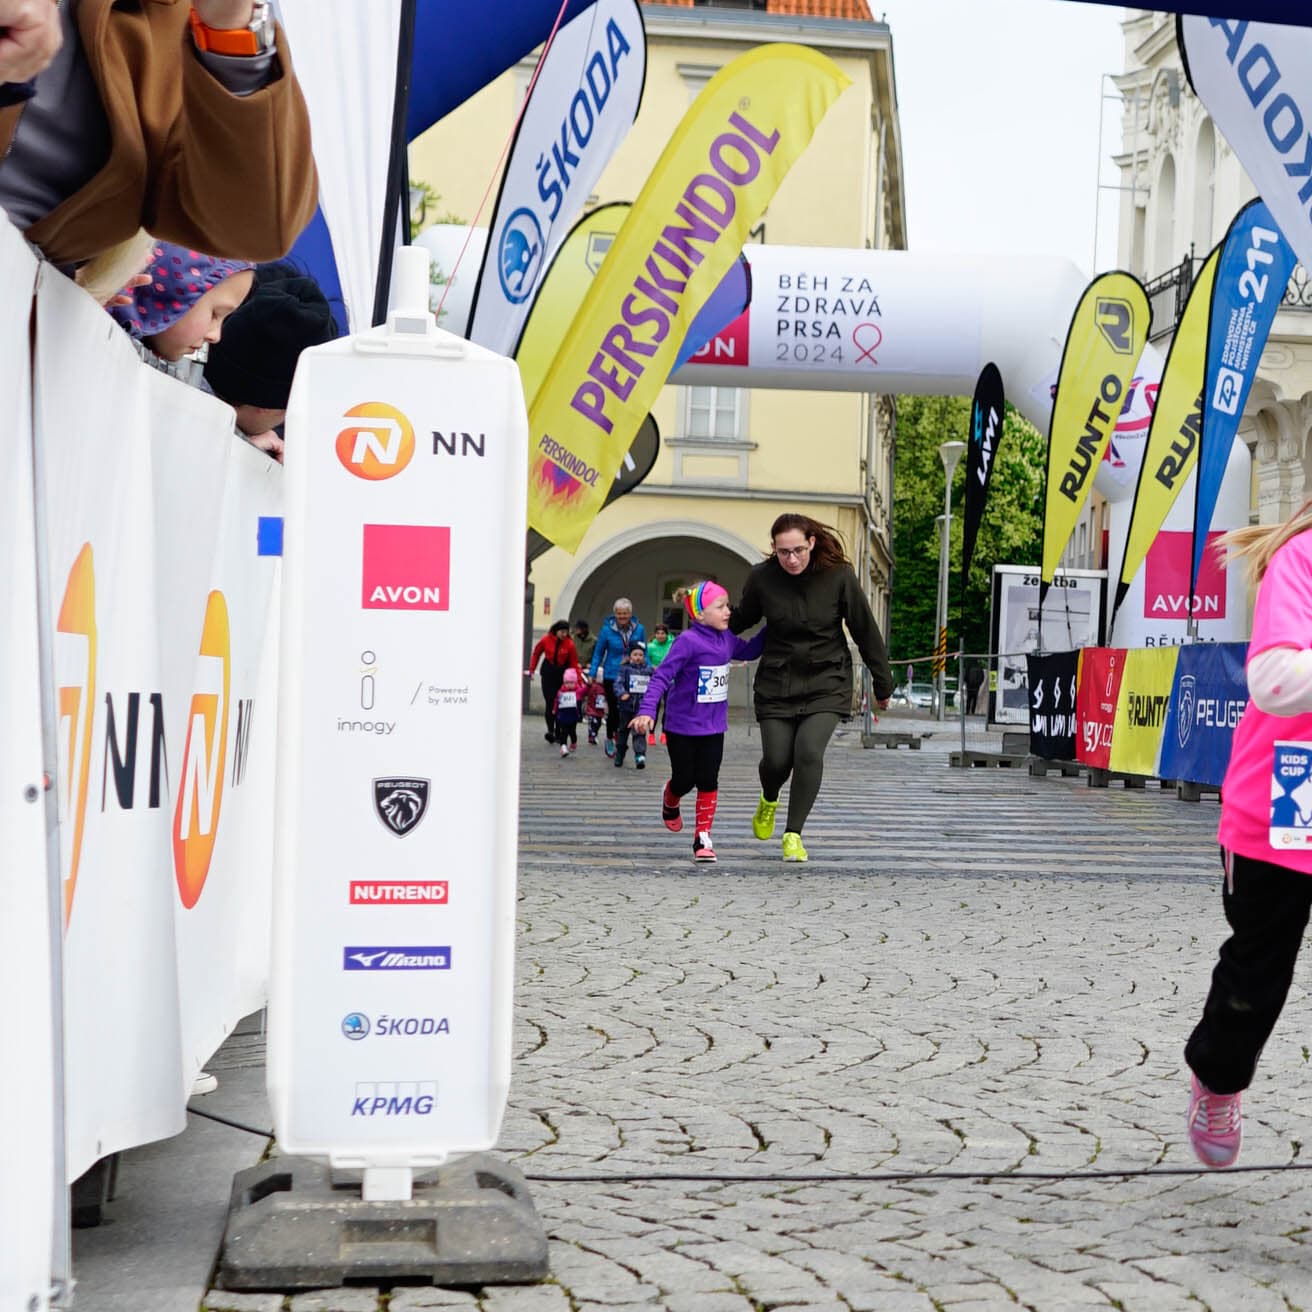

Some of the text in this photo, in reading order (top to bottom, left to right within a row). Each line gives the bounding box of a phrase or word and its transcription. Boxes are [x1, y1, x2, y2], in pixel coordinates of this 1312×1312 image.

[535, 17, 631, 223] ŠKODA
[570, 110, 781, 435] PERSKINDOL
[1238, 225, 1278, 303] 211
[778, 272, 873, 293] BĚH ZA
[777, 295, 882, 317] ZDRAVÁ
[776, 319, 842, 339] PRSA
[776, 342, 845, 364] 2024
[431, 431, 485, 457] NN
[1155, 391, 1203, 490] RUN
[538, 433, 600, 489] PERSKINDOL
[369, 585, 440, 604] AVON
[1151, 594, 1219, 612] AVON
[428, 685, 469, 695] Powered
[428, 696, 468, 706] by MVM
[1196, 698, 1246, 728] PEUGE
[336, 717, 396, 736] innogy
[1280, 754, 1308, 765] KIDS
[1280, 766, 1305, 776] CUP
[376, 781, 426, 789] PEUGEOT
[354, 885, 445, 900] NUTREND
[375, 1014, 450, 1036] ŠKODA
[351, 1095, 434, 1117] KPMG
